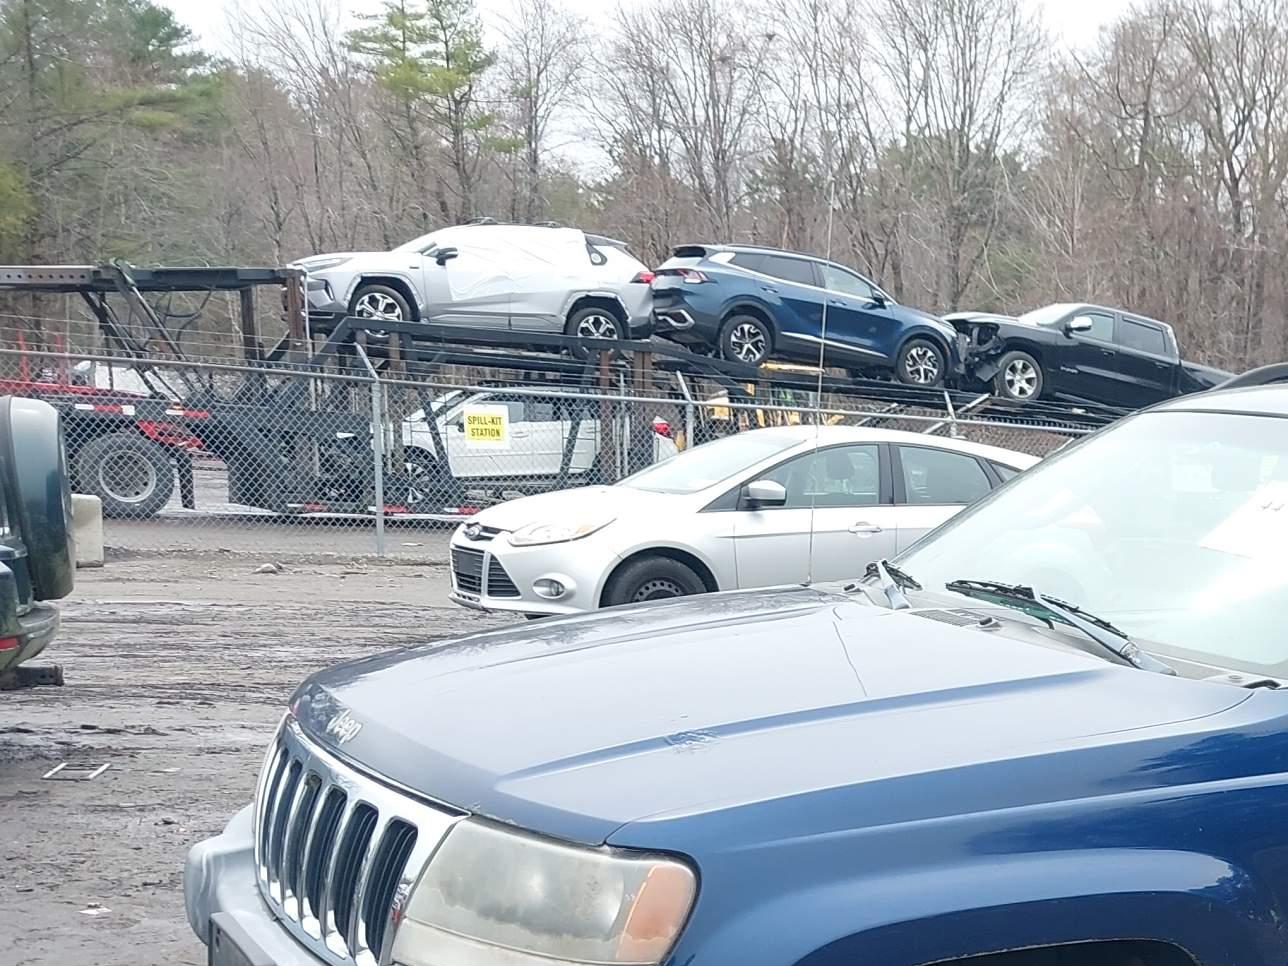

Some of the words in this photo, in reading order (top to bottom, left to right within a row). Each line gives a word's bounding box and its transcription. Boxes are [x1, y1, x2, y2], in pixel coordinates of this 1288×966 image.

[467, 415, 502, 425] SPILL-KIT
[471, 428, 501, 437] STATION
[326, 708, 363, 744] Jeep
